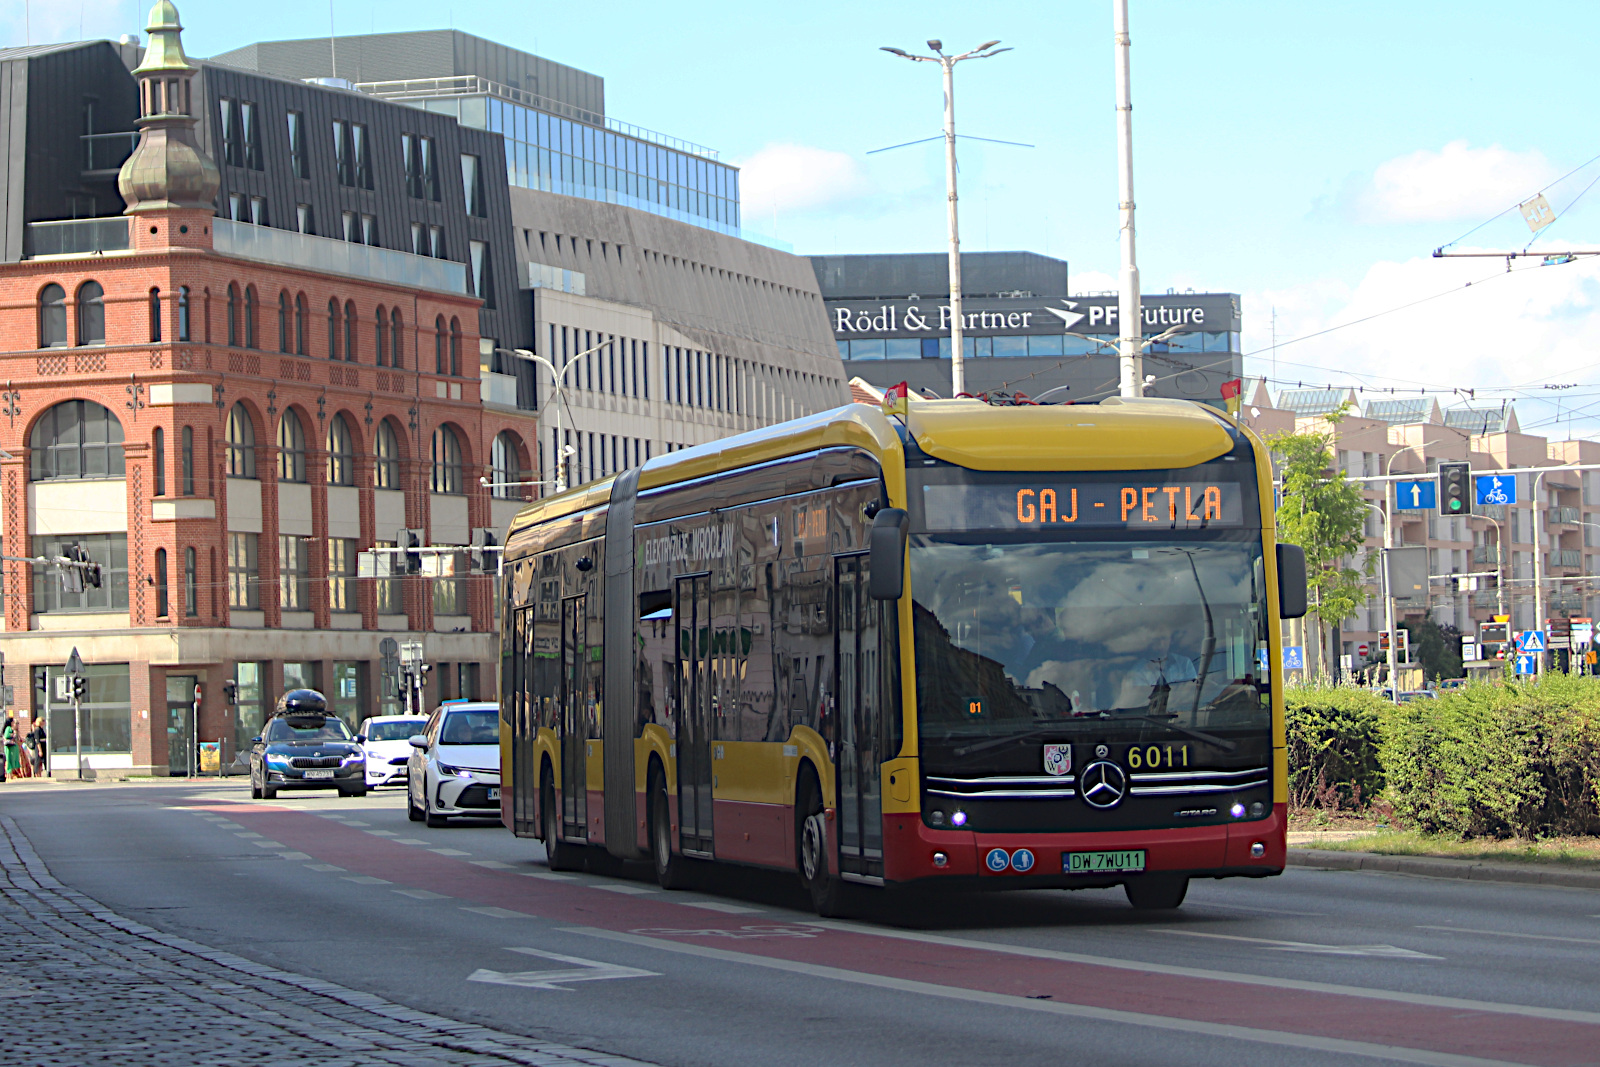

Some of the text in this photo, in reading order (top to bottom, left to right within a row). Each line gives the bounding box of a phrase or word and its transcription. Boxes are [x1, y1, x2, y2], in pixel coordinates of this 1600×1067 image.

[835, 305, 898, 332] Rödl
[903, 306, 932, 331] &
[1016, 488, 1078, 523] GAJ
[692, 522, 734, 560] WROCŁAW
[969, 701, 981, 714] 01
[1128, 744, 1188, 769] 6011
[1072, 853, 1140, 869] DW 7WU11
